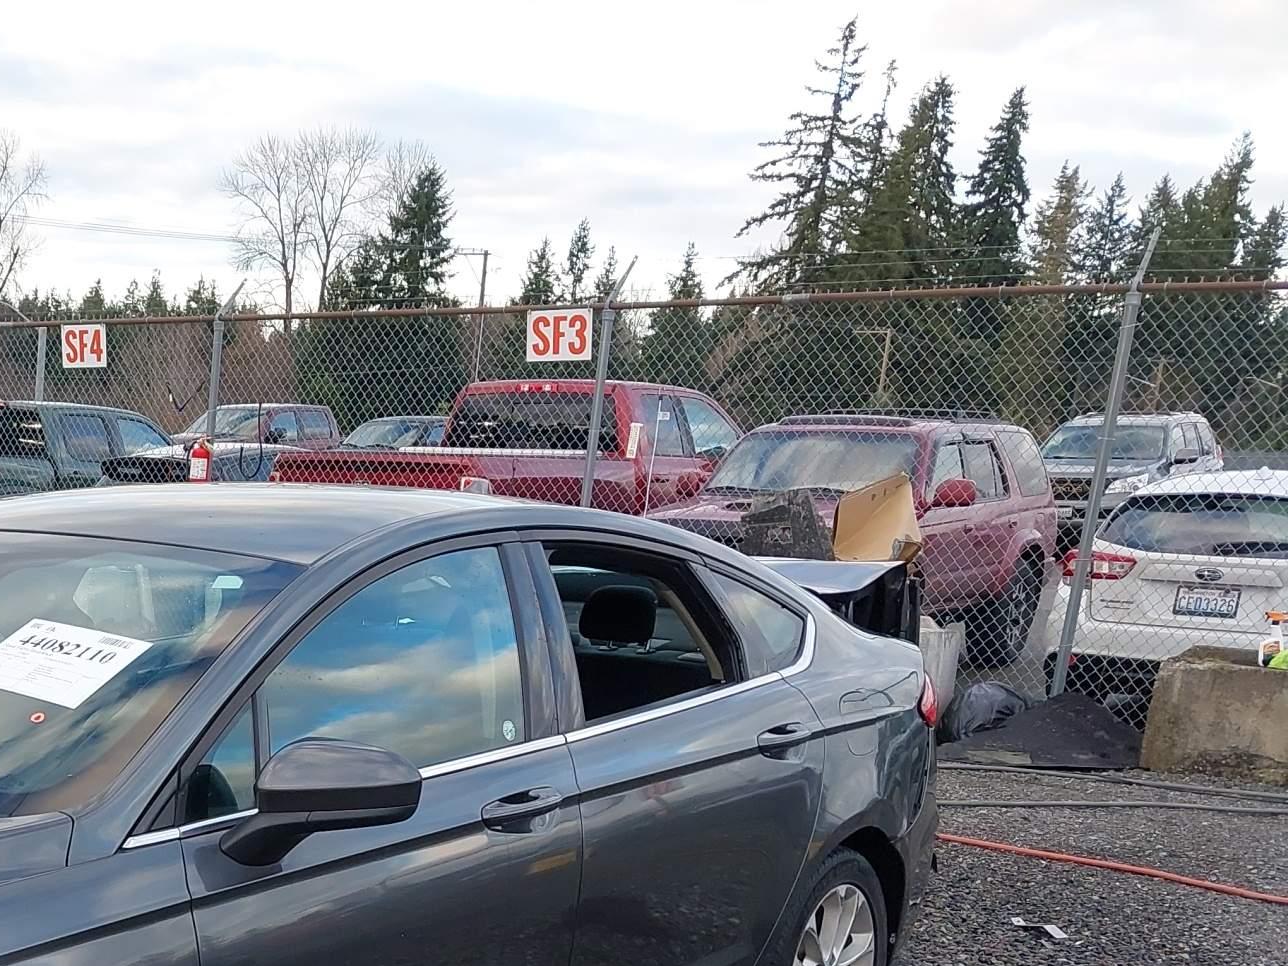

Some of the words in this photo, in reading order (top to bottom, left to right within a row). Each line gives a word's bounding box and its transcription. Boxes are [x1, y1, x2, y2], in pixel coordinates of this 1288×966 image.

[64, 329, 103, 364] SF4
[532, 315, 587, 356] SF3
[1178, 596, 1235, 613] CED3326
[19, 634, 117, 664] 44082110
